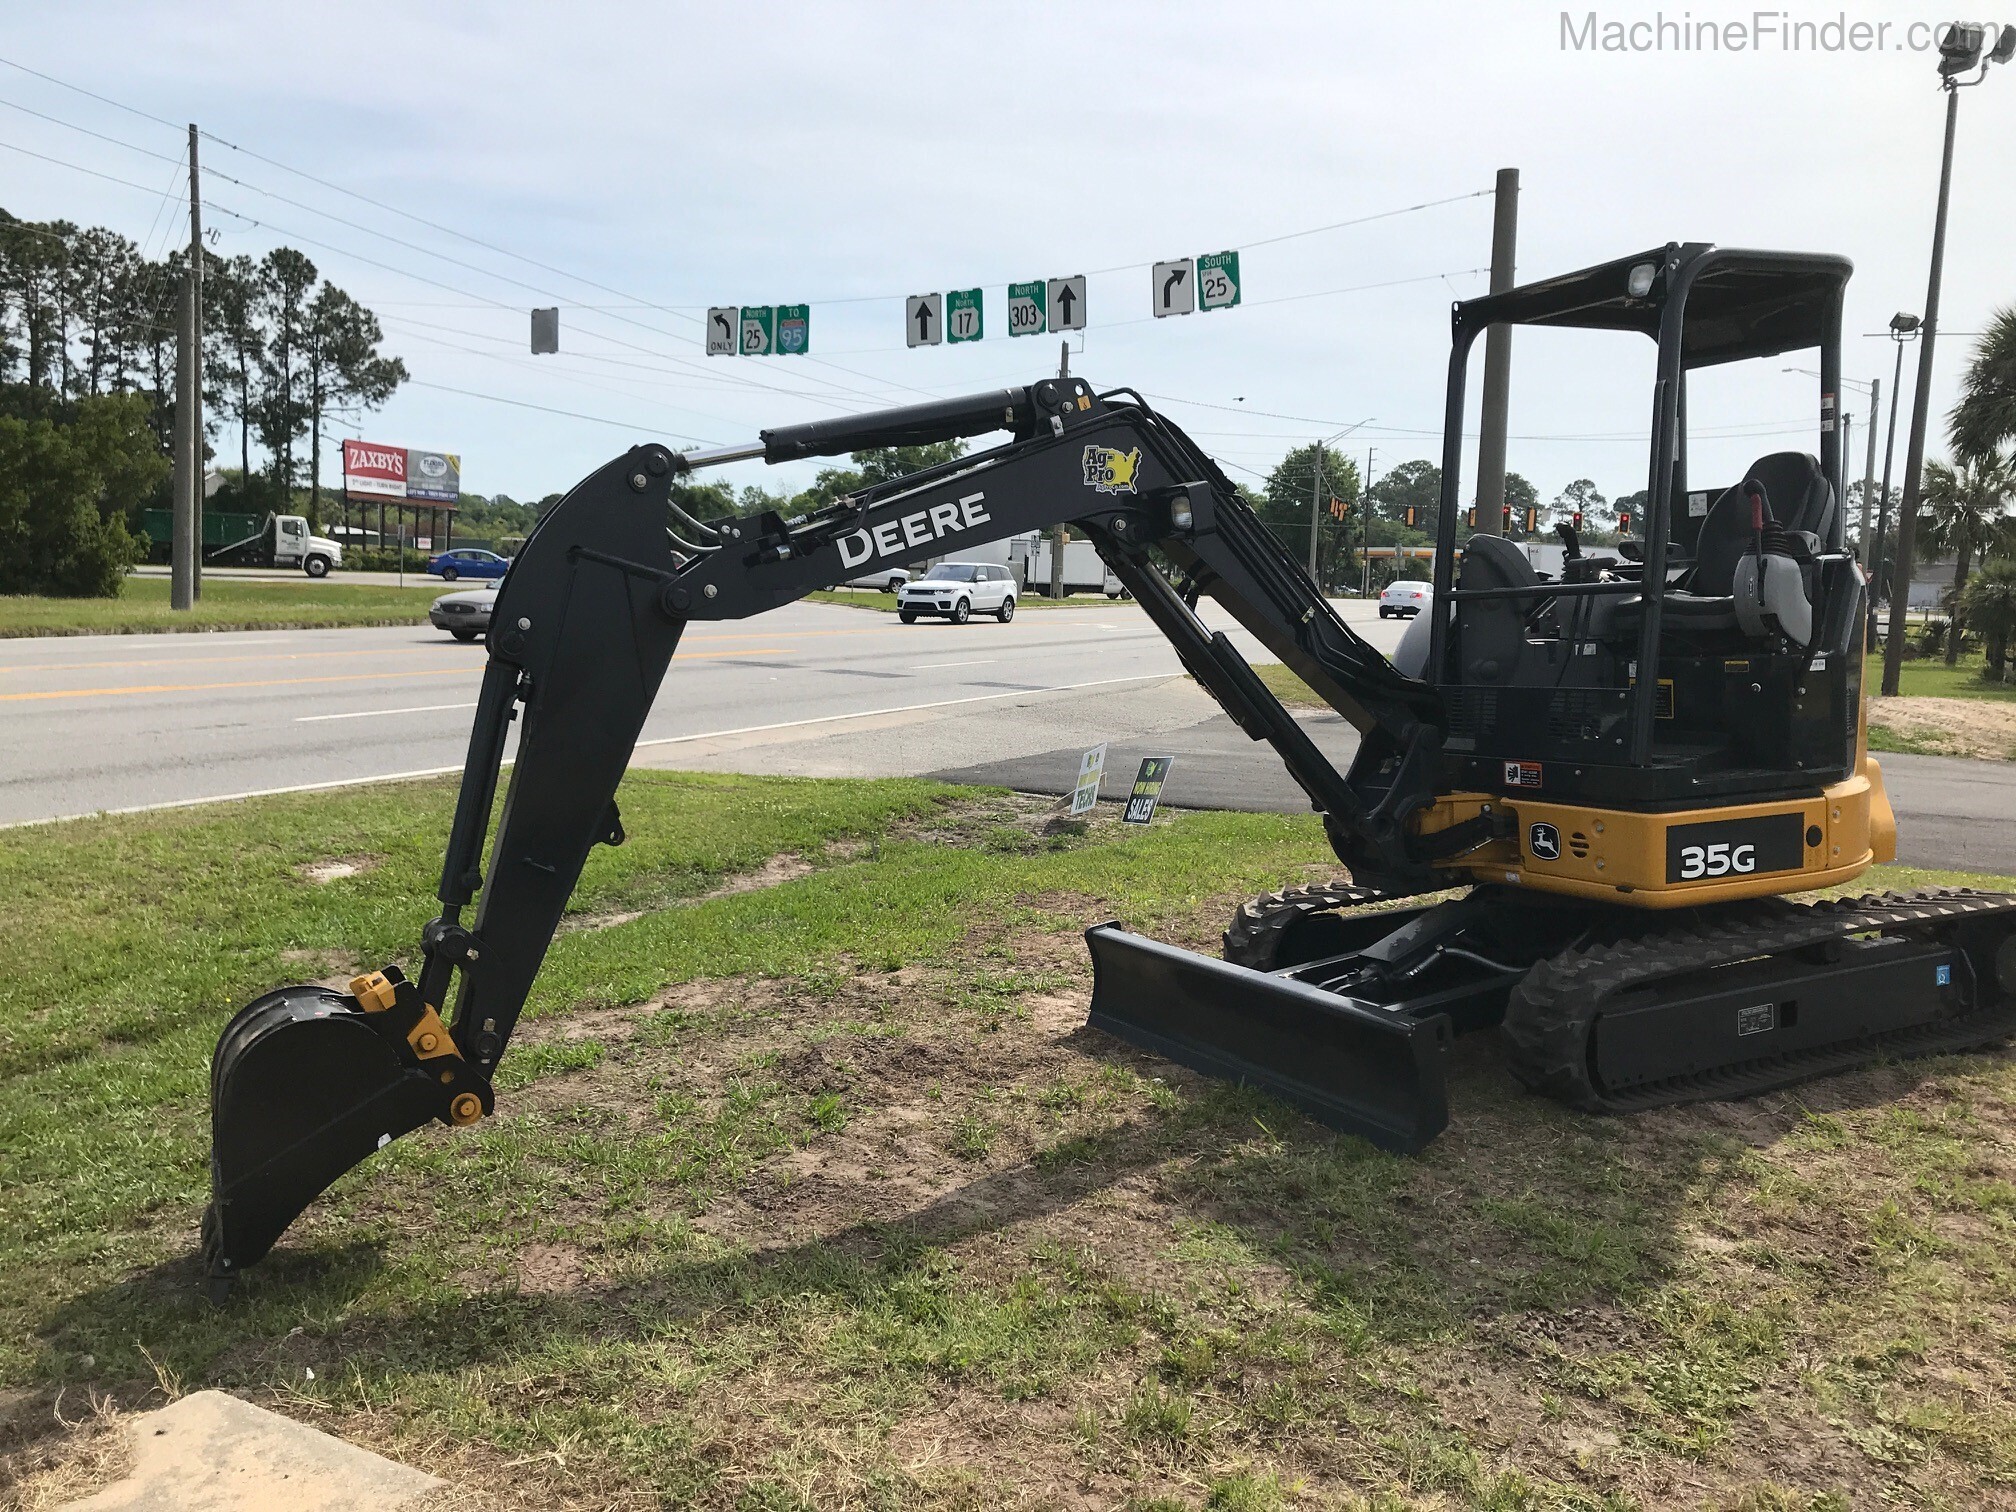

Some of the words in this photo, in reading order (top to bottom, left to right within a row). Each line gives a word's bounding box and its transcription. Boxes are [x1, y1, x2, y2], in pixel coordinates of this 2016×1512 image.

[1204, 255, 1232, 268] SOUTH
[1014, 285, 1039, 296] NORTH
[1205, 276, 1227, 298] 25
[745, 309, 767, 318] NORTH
[788, 308, 800, 318] TO
[1012, 304, 1037, 327] 303
[958, 313, 972, 334] 17
[711, 341, 733, 351] ONLY
[746, 329, 760, 349] 25
[782, 329, 802, 346] 95
[350, 448, 403, 476] ZAXBY'S
[1086, 448, 1113, 468] Ag-
[1086, 466, 1114, 482] Pro
[836, 491, 991, 570] DEERE
[1127, 798, 1154, 820] SALES
[1680, 843, 1755, 878] 35G
